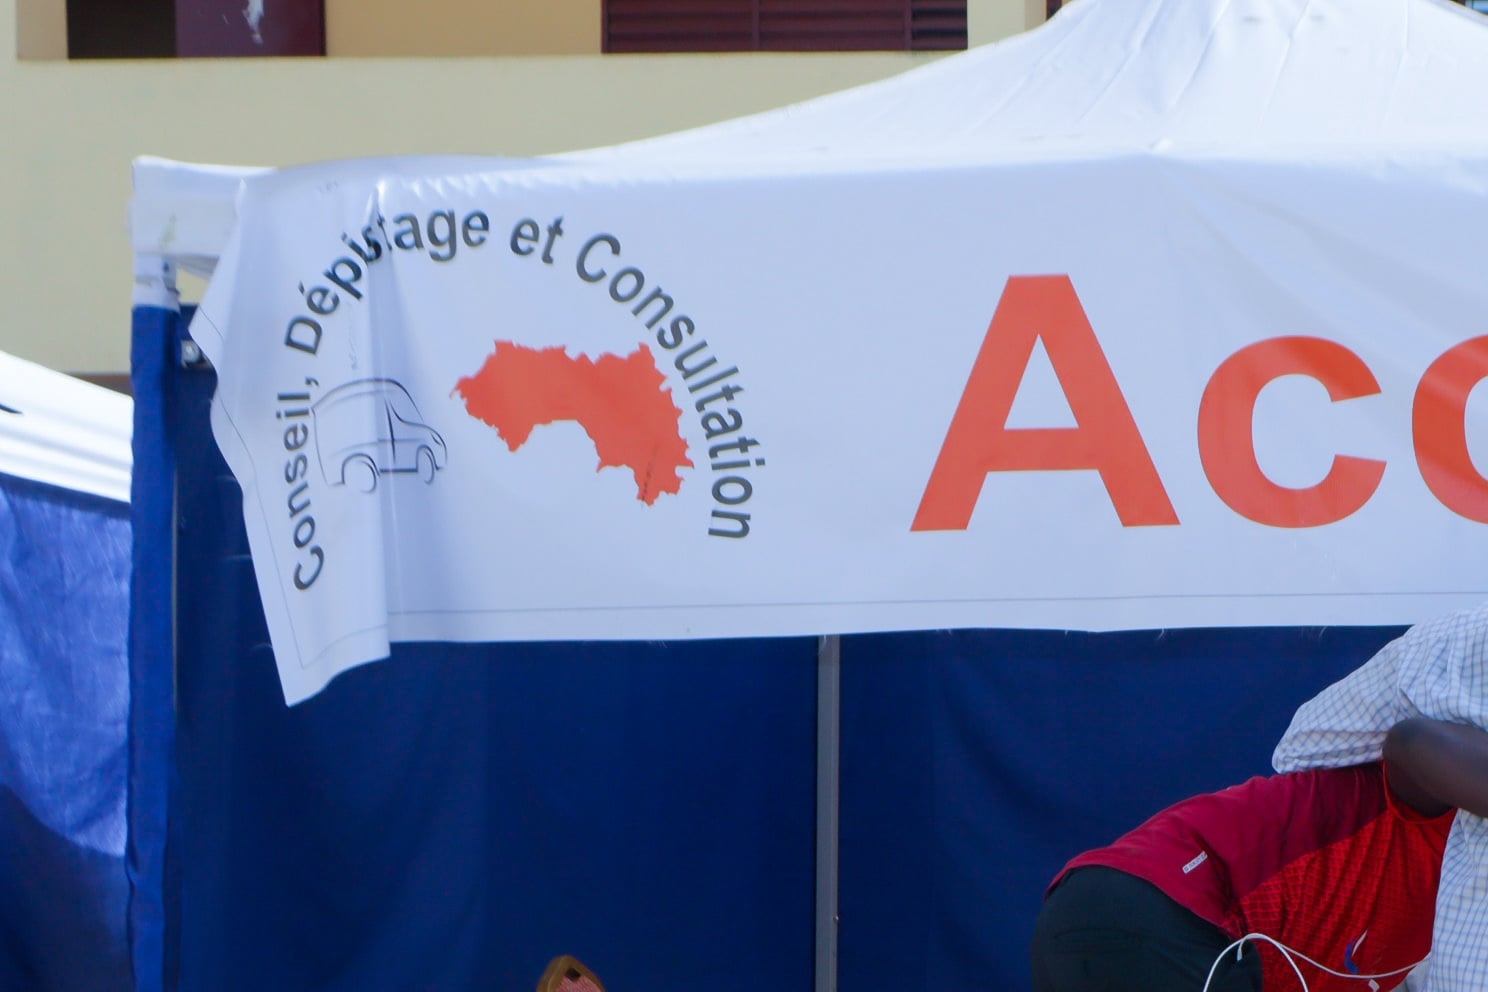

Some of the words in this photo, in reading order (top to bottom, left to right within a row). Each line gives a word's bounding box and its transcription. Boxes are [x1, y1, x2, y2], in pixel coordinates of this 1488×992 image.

[284, 208, 491, 355] Dépistage
[509, 215, 564, 265] et
[575, 231, 767, 540] Consultation
[275, 375, 325, 591] Conseil,
